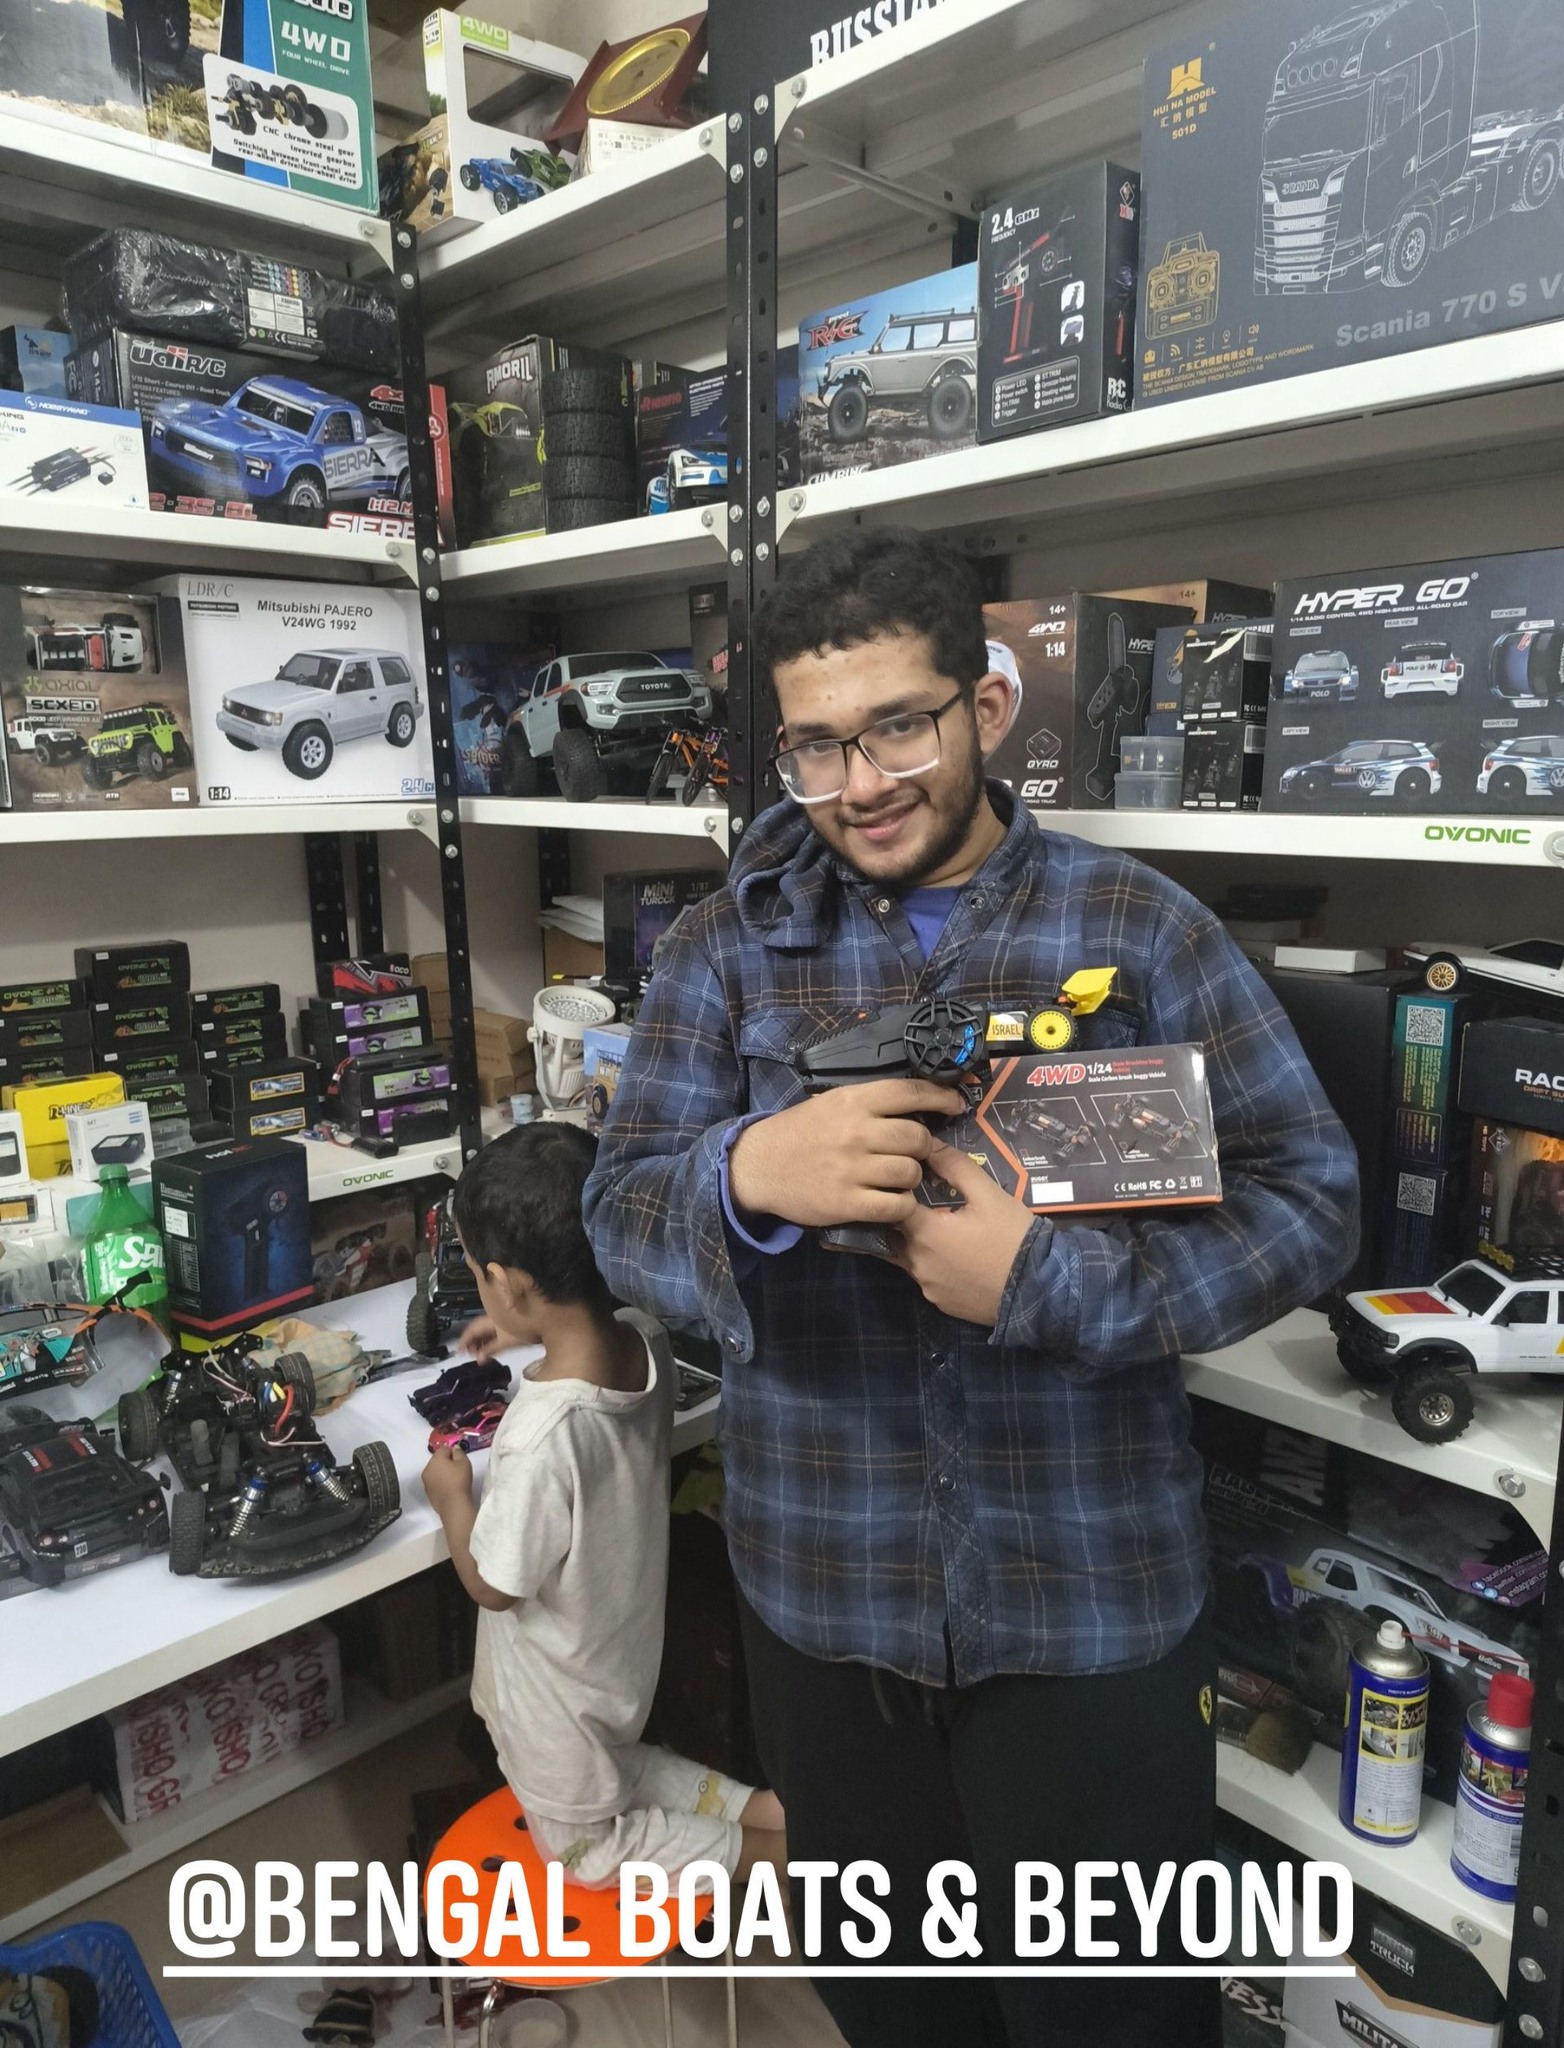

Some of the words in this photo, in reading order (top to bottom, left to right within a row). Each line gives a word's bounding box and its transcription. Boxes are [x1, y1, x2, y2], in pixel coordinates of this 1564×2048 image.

[462, 17, 508, 41] 4WD
[281, 20, 351, 62] 4WD
[282, 49, 301, 61] FOUR
[304, 56, 327, 70] WHEEL
[330, 64, 350, 76] DRIVE
[1153, 104, 1169, 117] HUI
[1171, 99, 1183, 110] NA
[1186, 87, 1217, 105] MODEL
[1172, 123, 1197, 140] 501D
[263, 125, 280, 137] CNC
[284, 132, 312, 147] chrome
[315, 140, 334, 153] steel
[338, 147, 355, 158] gear
[271, 149, 300, 164] between
[290, 144, 322, 160] Inverted
[327, 155, 356, 169] gearbox
[992, 207, 1014, 236] 2.4
[991, 228, 1016, 244] FREQUENCY
[1336, 309, 1431, 348] Scania
[1442, 290, 1497, 323] 770
[1507, 282, 1528, 308] S
[1539, 272, 1564, 300] V
[1265, 353, 1278, 361] AND
[325, 448, 386, 479] SIERRA
[187, 581, 234, 599] LDR/C
[1180, 590, 1196, 599] 14+
[1294, 584, 1404, 616] HYPER
[1416, 576, 1470, 602] GO
[257, 600, 321, 614] Mitsubishi
[324, 604, 373, 618] PAJERO
[1050, 605, 1066, 615] 14+
[1305, 614, 1325, 622] RADIO
[1326, 612, 1357, 620] CONTROL
[1374, 605, 1415, 615] HIGH-SPEED
[1416, 603, 1451, 611] ALL-ROAD
[1453, 600, 1468, 608] CAR
[1504, 608, 1519, 617] VIEW
[282, 616, 326, 629] V24WG
[330, 619, 357, 631] 1992
[1029, 621, 1066, 634] 4WD
[1401, 618, 1415, 626] VIEW
[1308, 626, 1321, 635] VIEW
[1046, 641, 1066, 657] 1:14
[1128, 638, 1155, 651] HYPE
[641, 683, 669, 691] TOYOTA
[1310, 690, 1330, 698] POLO
[1501, 719, 1517, 727] VIEW
[1027, 760, 1059, 769] GYRO
[209, 787, 231, 799] 1:14
[1021, 780, 1058, 797] GO
[1424, 825, 1532, 844] OVONIC
[4, 990, 44, 1000] OVONIC
[992, 1024, 1021, 1036] ISRAEL
[1027, 1064, 1085, 1087] 4WD
[1087, 1062, 1112, 1074] 1/24
[1133, 1073, 1148, 1081] buggy
[1148, 1071, 1166, 1079] Vehicle
[1523, 1085, 1550, 1096] DRIFT
[342, 1169, 394, 1187] OVONIC
[1128, 1182, 1147, 1190] RoHS
[1149, 1181, 1162, 1190] FC
